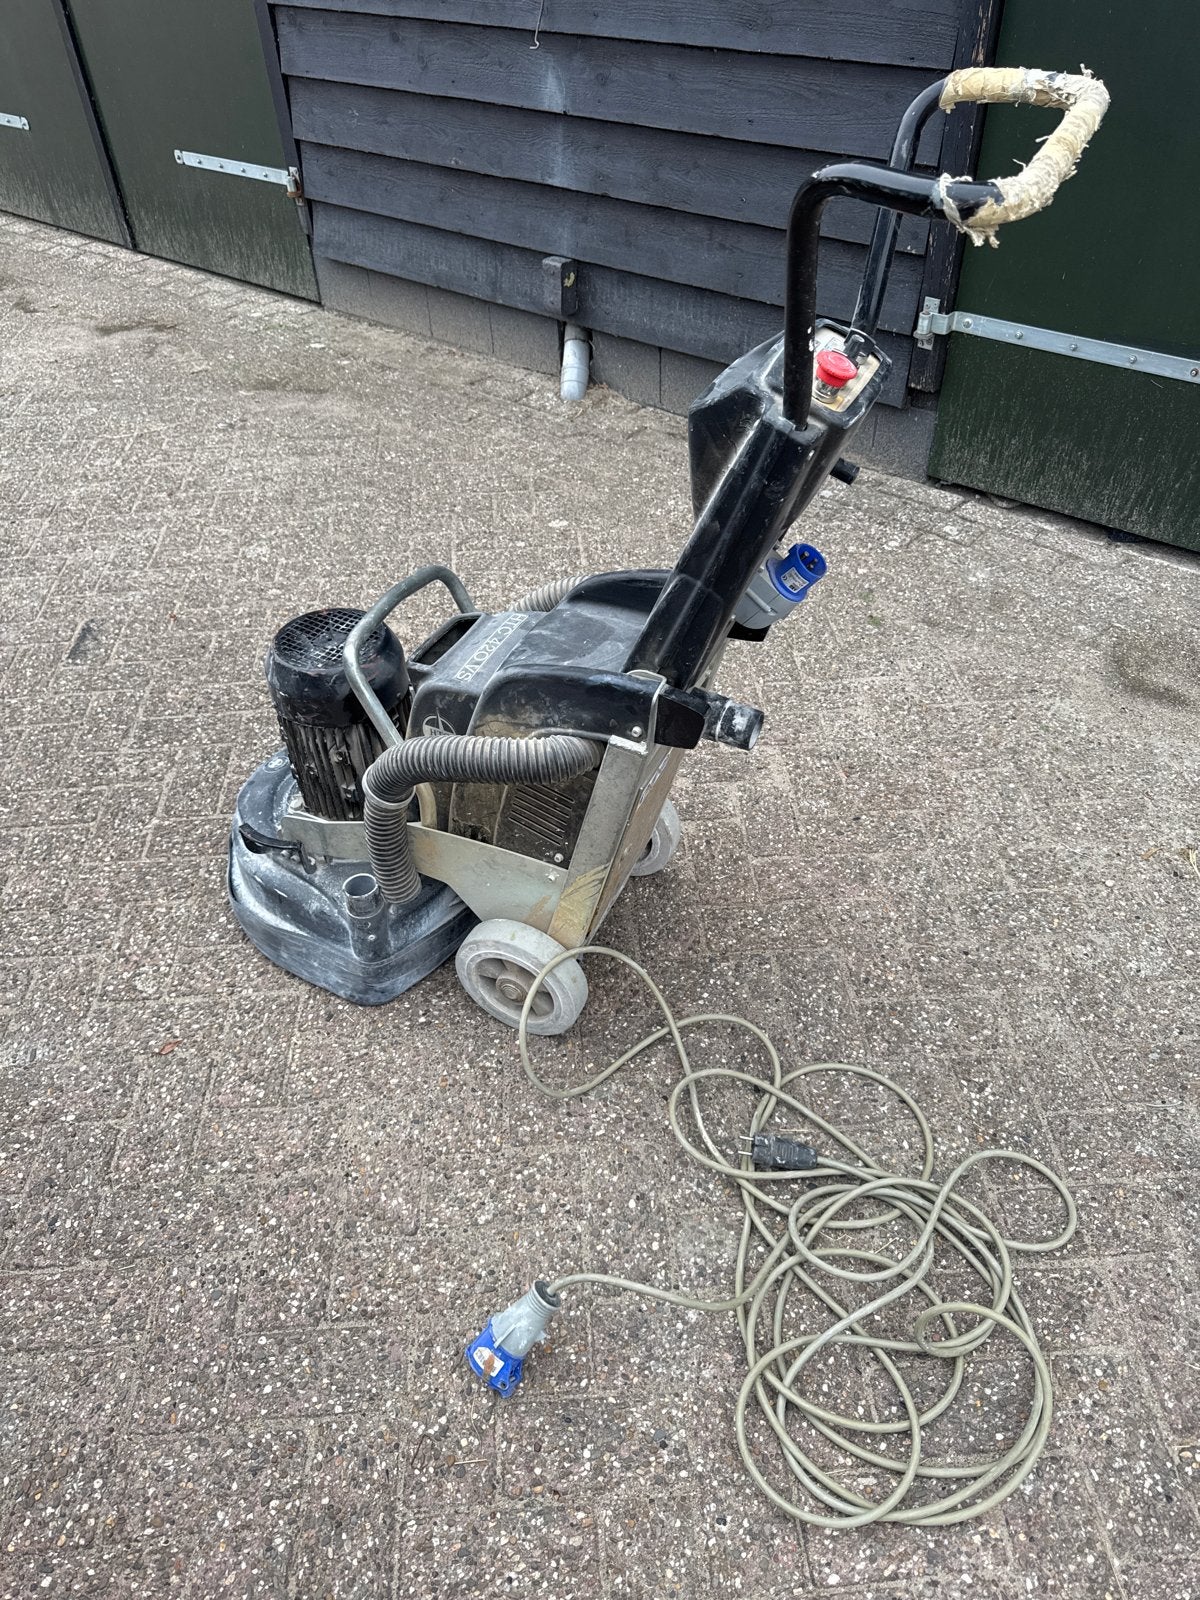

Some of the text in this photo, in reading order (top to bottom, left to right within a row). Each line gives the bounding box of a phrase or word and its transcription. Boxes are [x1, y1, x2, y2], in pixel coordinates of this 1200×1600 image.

[456, 613, 528, 681] HTC 420 VS
